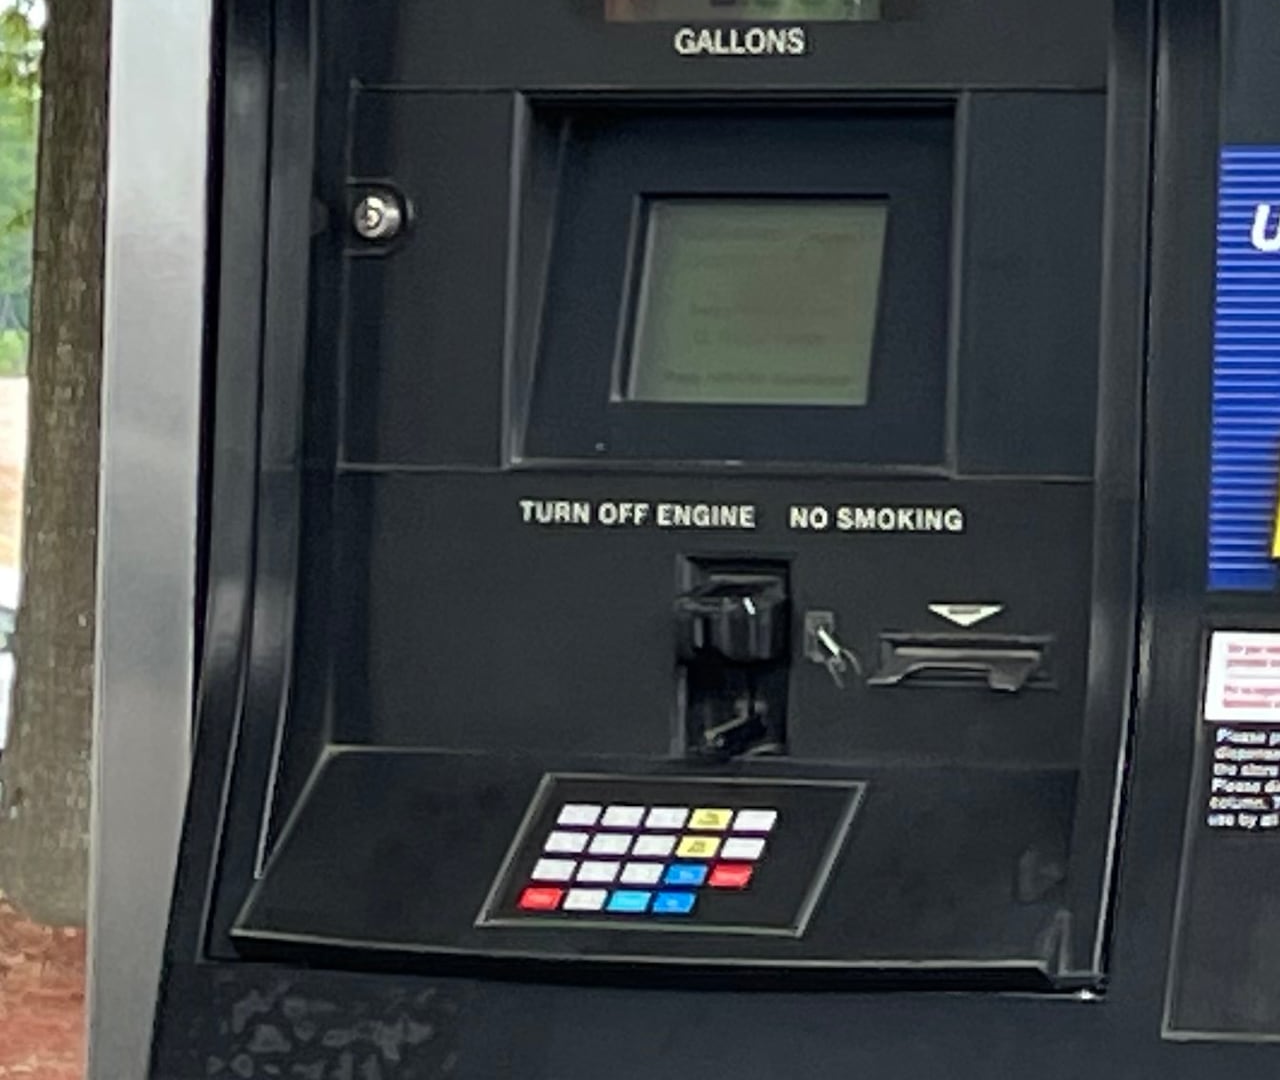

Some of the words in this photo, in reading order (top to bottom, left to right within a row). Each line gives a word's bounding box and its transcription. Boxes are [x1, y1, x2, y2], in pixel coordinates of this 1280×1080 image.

[674, 27, 806, 56] GALLONS
[520, 500, 589, 524] TURN
[599, 502, 648, 525] OFF
[657, 503, 756, 528] ENGINE
[790, 506, 826, 530] NO
[836, 506, 964, 532] SMOKING
